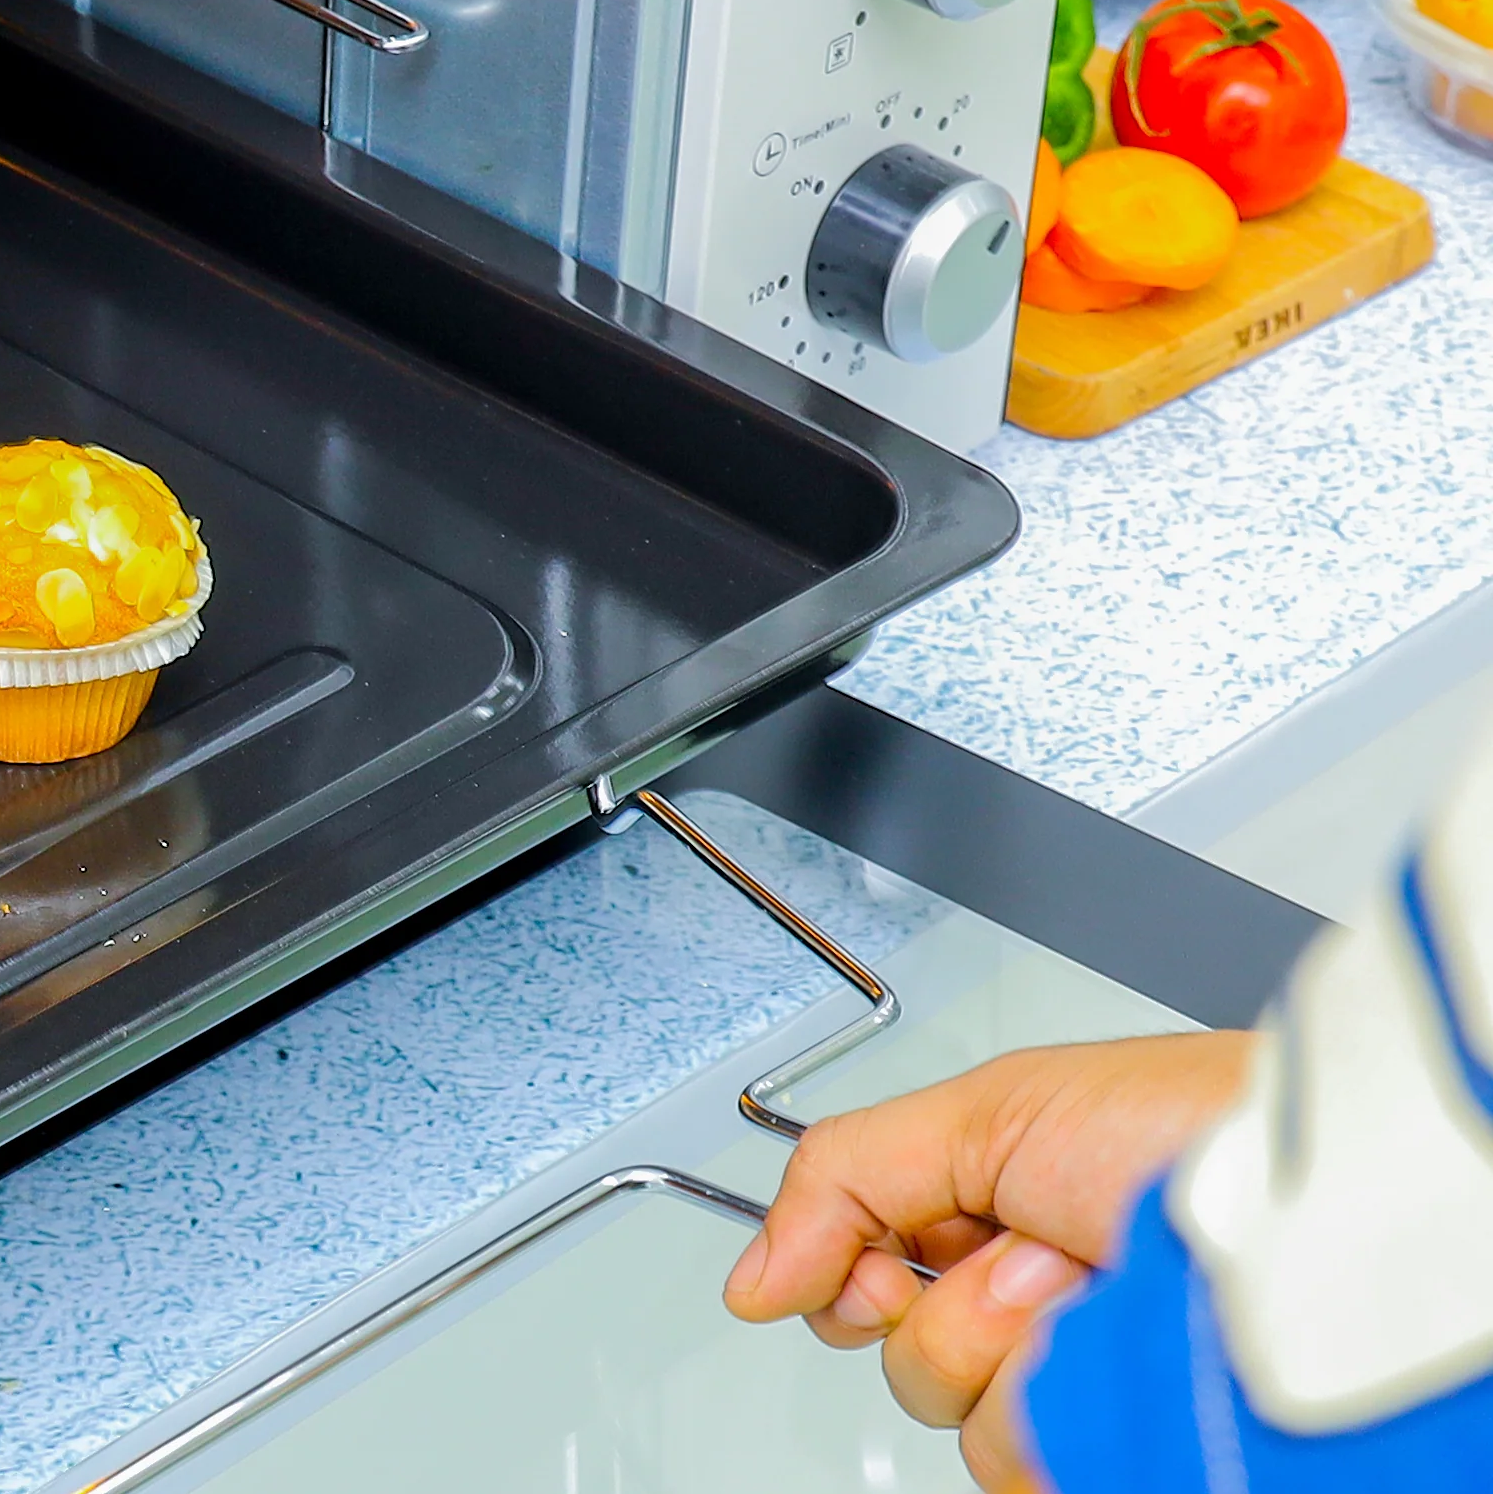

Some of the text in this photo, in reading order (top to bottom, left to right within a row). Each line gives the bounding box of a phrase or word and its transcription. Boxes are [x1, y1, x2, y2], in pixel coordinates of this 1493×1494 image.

[875, 91, 902, 114] OFF
[790, 176, 814, 196] ON
[749, 281, 775, 305] 120
[1234, 301, 1305, 349] IKEA
